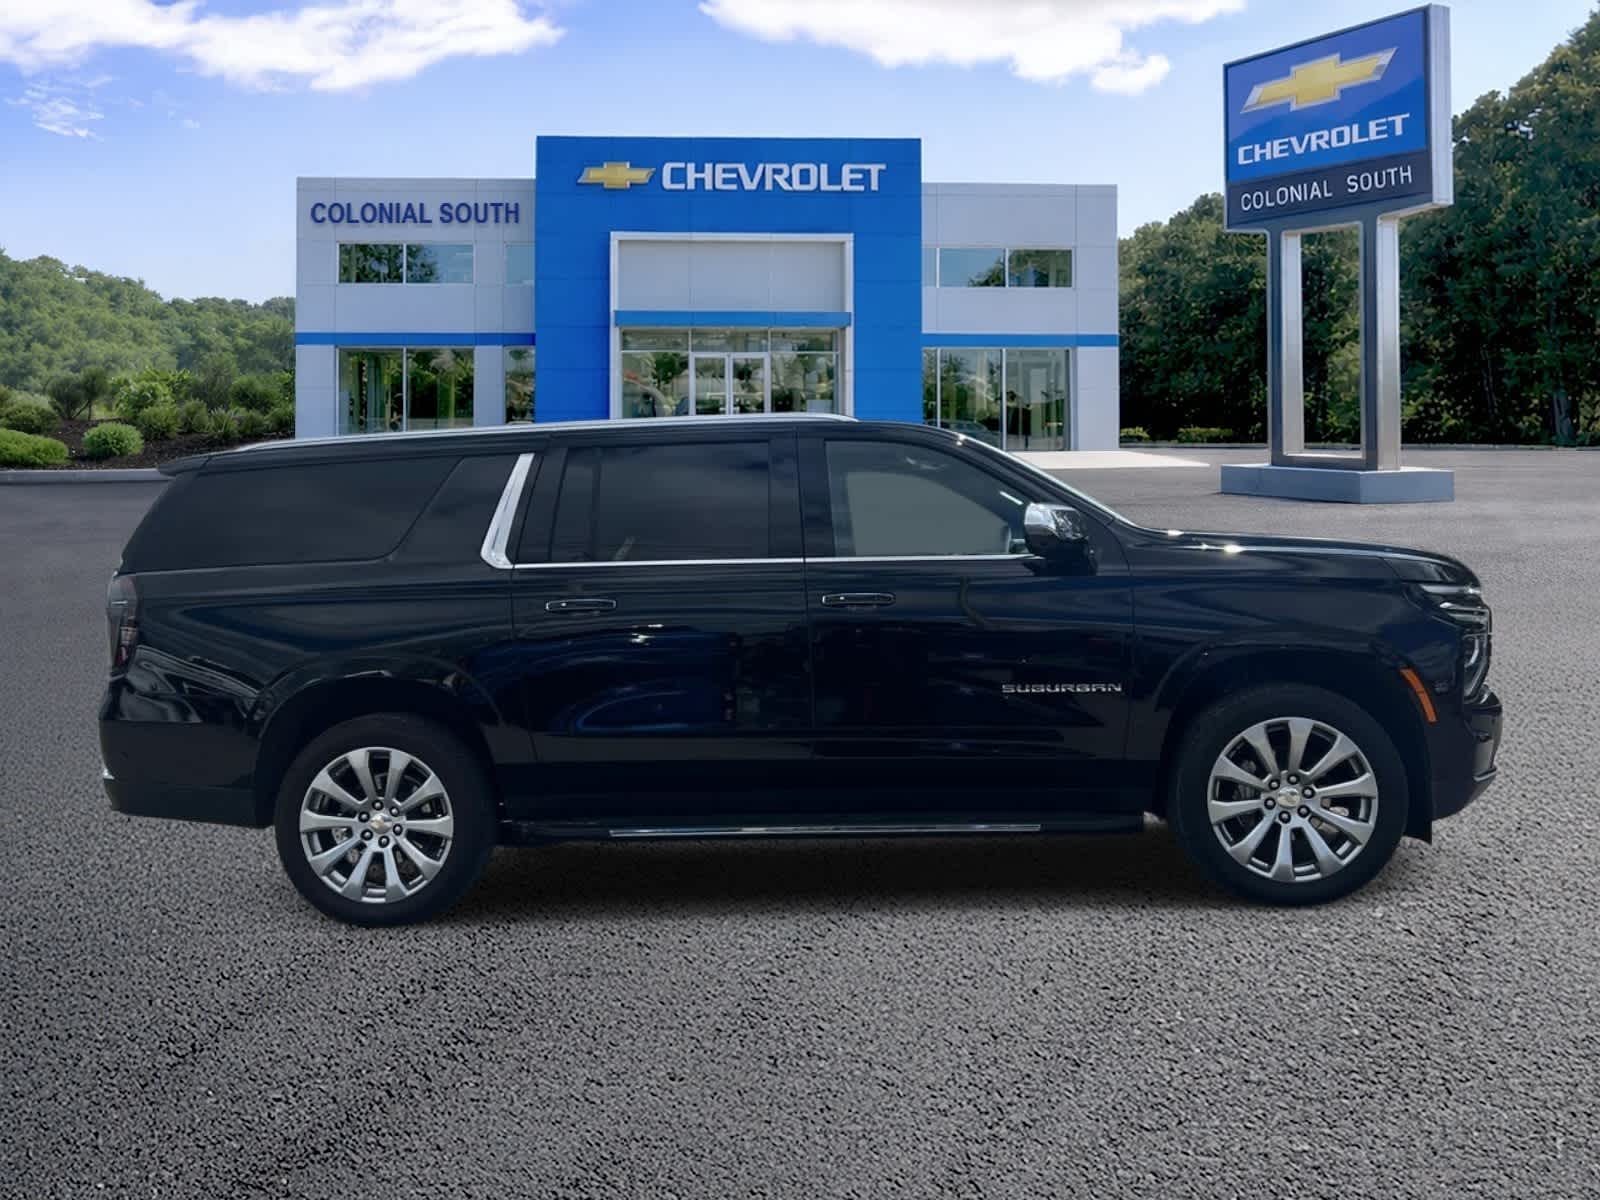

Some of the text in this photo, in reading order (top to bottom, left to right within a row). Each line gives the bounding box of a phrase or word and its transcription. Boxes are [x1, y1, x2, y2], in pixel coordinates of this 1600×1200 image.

[1238, 113, 1410, 165] CHEVROLET
[661, 161, 887, 193] CHEVROLET
[1240, 165, 1413, 211] COLONIAL SOUTH
[310, 202, 521, 225] COLONIAL SOUTH
[1001, 683, 1123, 694] SUBURBAN
